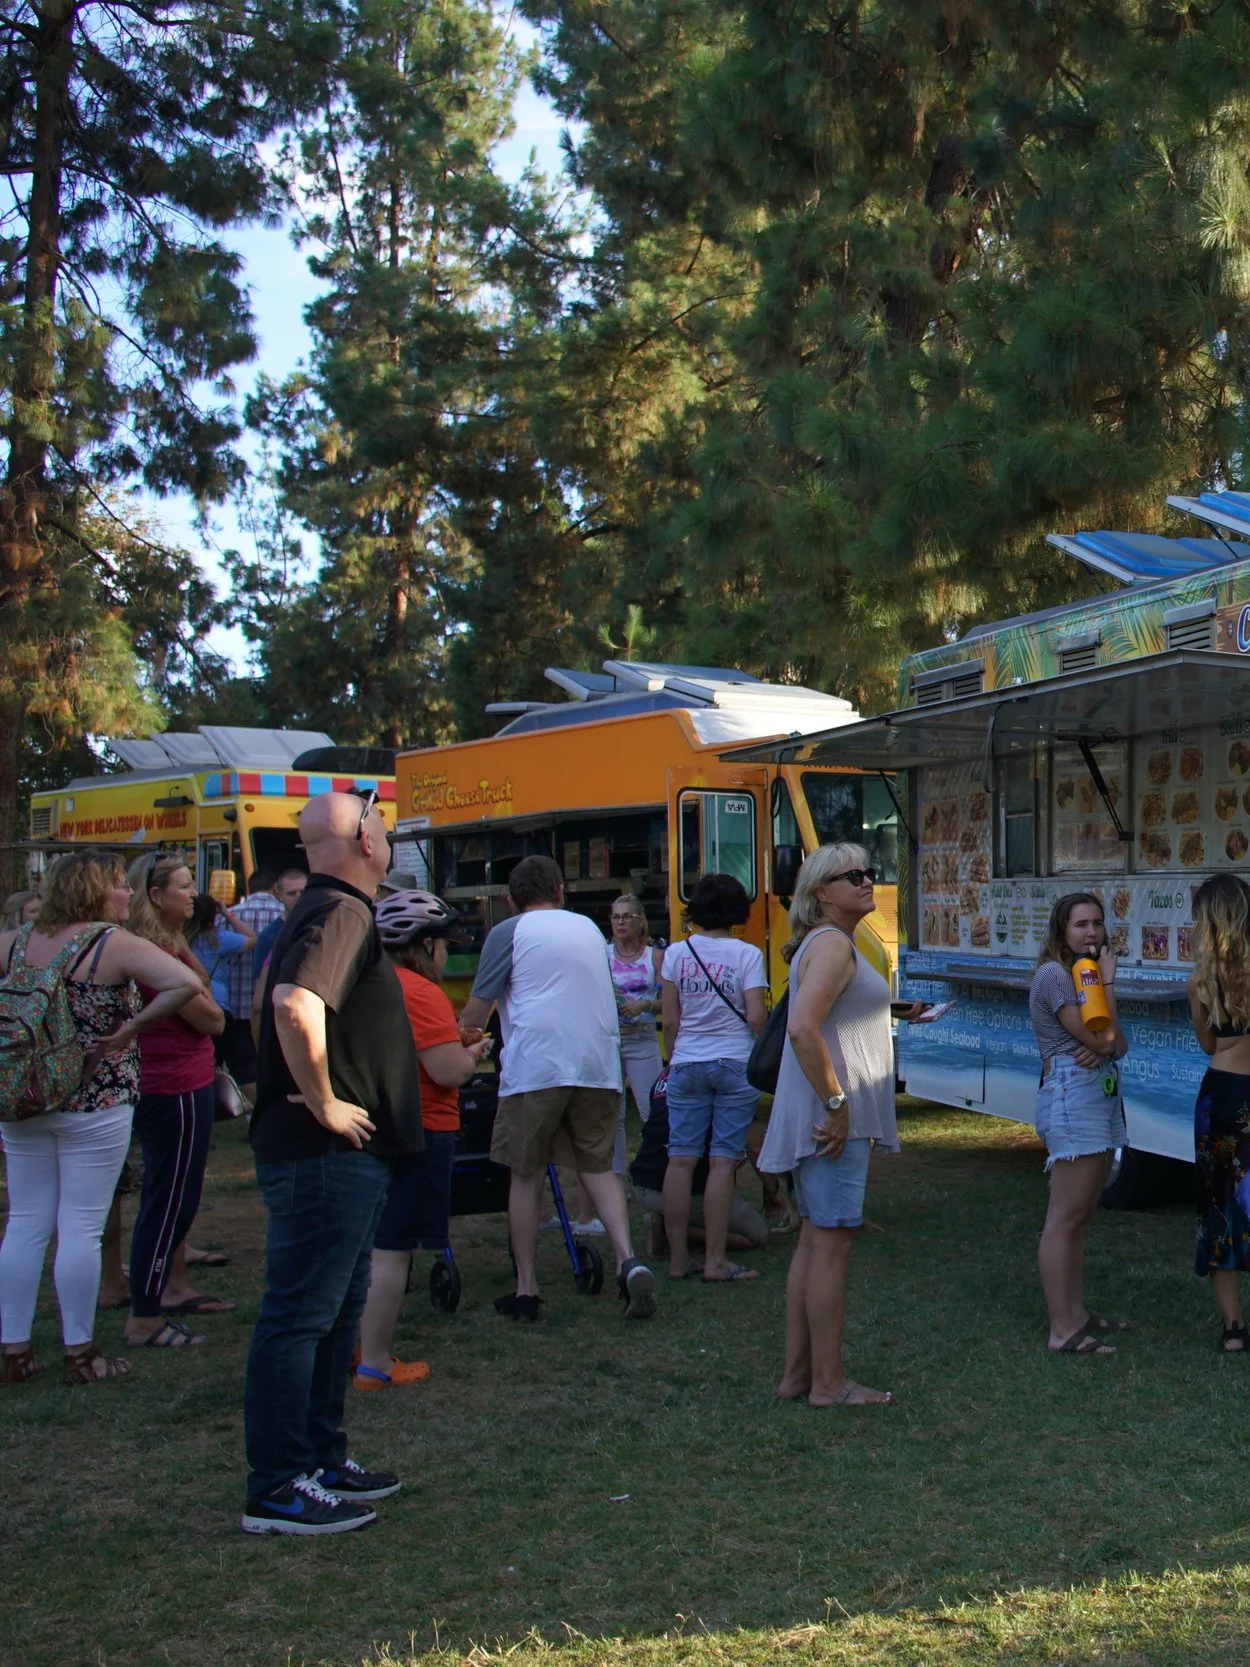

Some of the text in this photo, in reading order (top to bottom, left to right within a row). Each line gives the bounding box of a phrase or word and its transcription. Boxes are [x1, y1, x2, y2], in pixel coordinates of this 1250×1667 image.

[479, 776, 513, 805] Truck
[1148, 890, 1173, 909] Tacos
[965, 1005, 984, 1027] Free
[986, 1007, 1021, 1035] Options
[923, 1025, 949, 1045] Caught
[950, 1028, 980, 1048] Seafood
[985, 1035, 1008, 1055] Vegan
[1131, 1023, 1201, 1053] Vegan Frie
[1121, 1054, 1201, 1084] Angus Sustain
